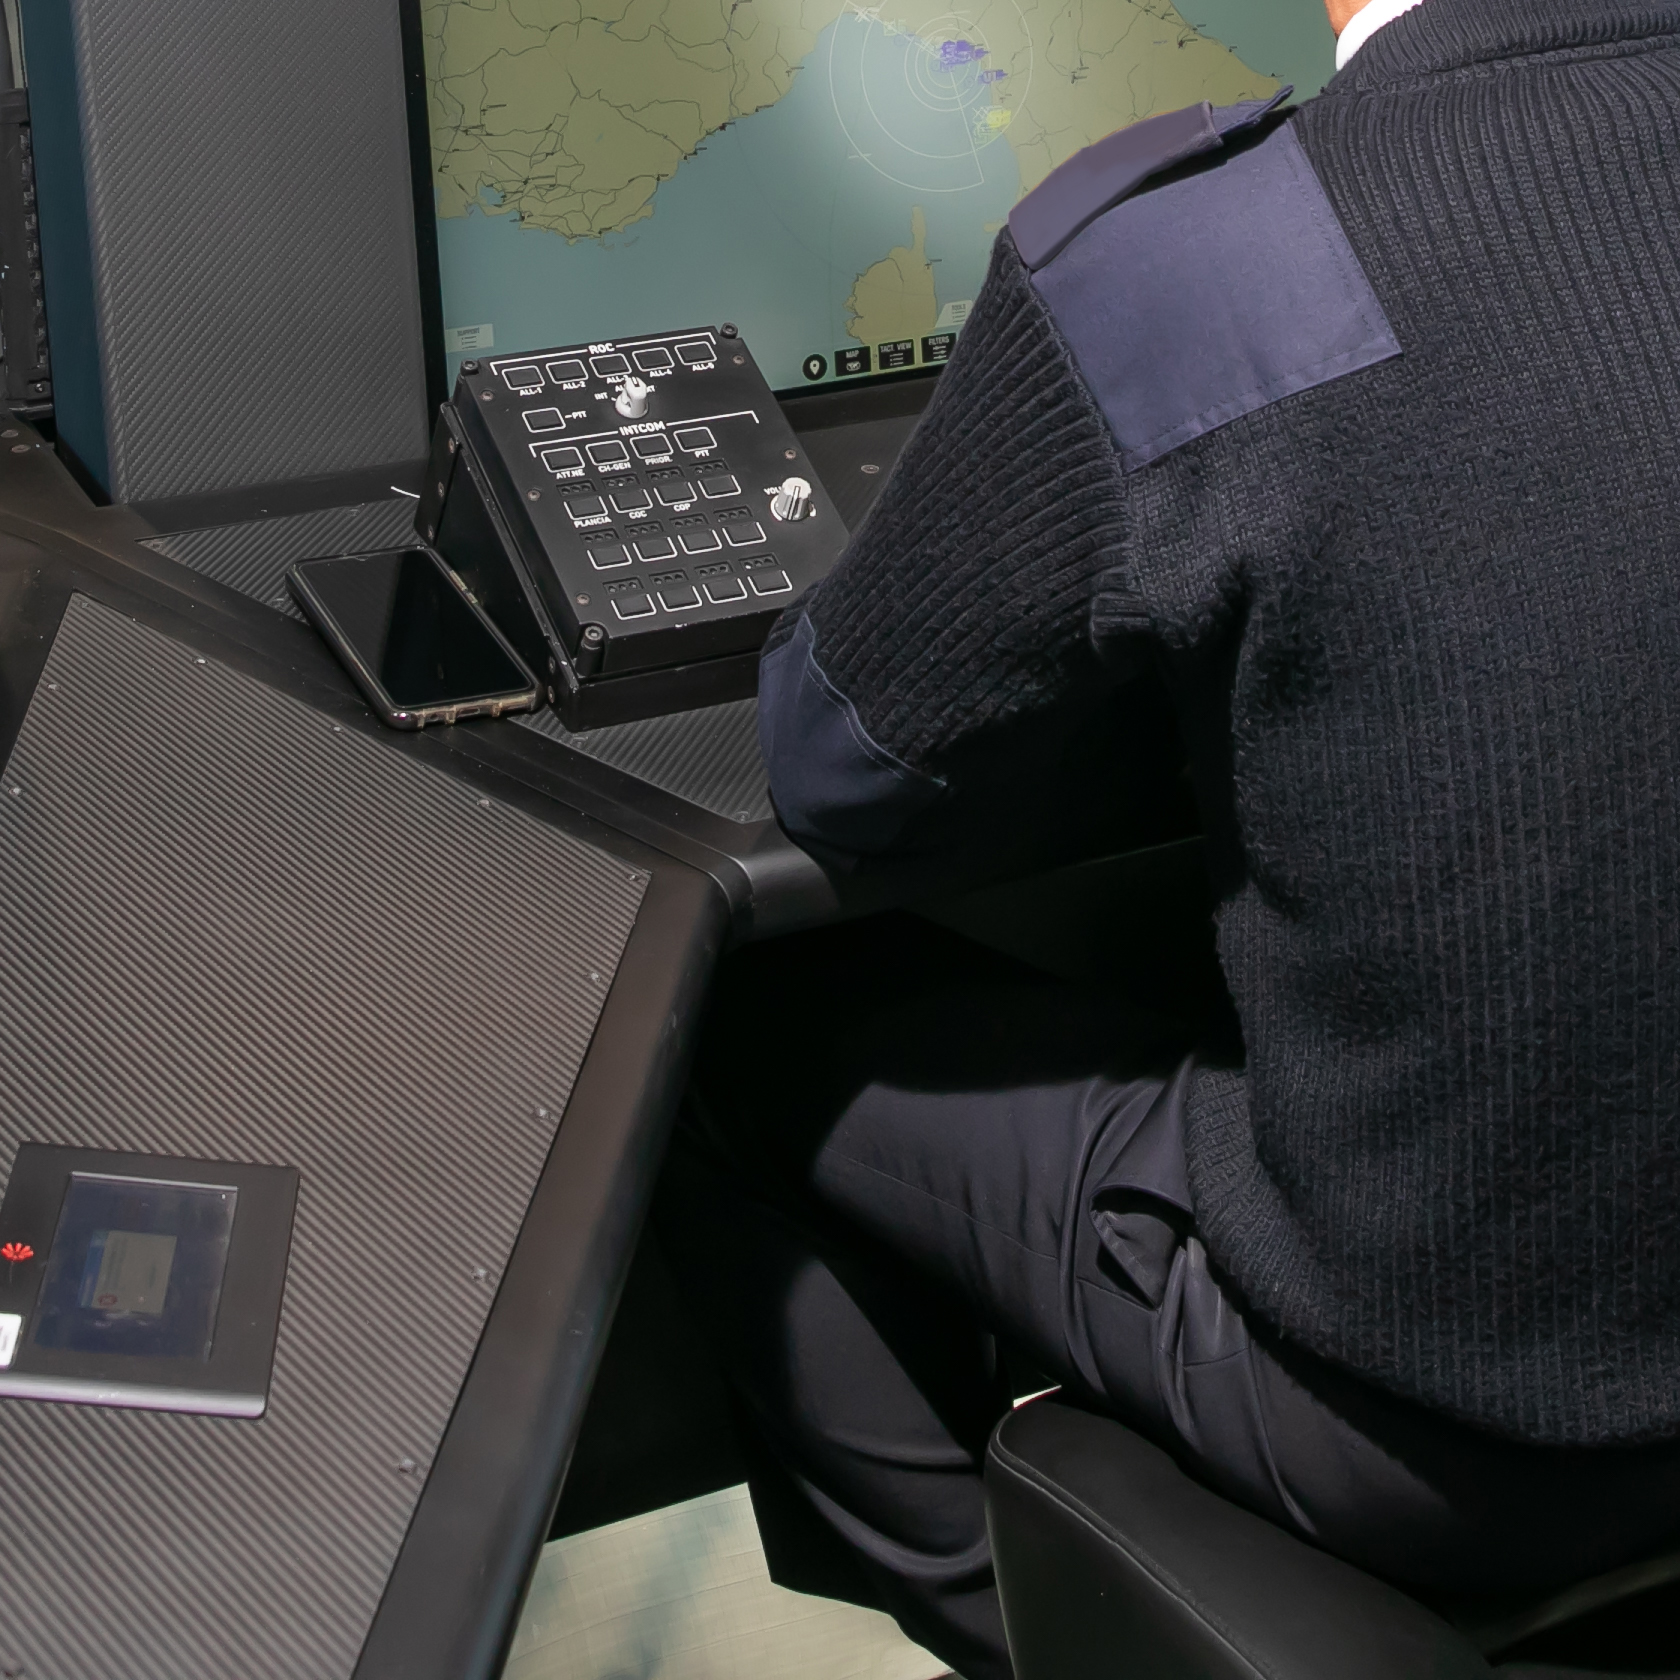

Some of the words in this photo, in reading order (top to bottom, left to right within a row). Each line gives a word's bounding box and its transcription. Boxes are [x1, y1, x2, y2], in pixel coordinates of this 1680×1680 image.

[928, 336, 949, 345] FILTERS
[588, 343, 615, 354] ROC
[896, 342, 912, 350] VIEW
[846, 350, 859, 358] MAP
[562, 381, 586, 390] ALL-2
[520, 388, 542, 396] ALL-1
[572, 411, 587, 419] PTT
[619, 421, 666, 435] INTCOM
[694, 450, 709, 458] PTT
[598, 462, 631, 473] CH-GEN
[673, 503, 691, 512] COP
[629, 510, 647, 519] COC
[574, 516, 612, 528] PLANCIA
